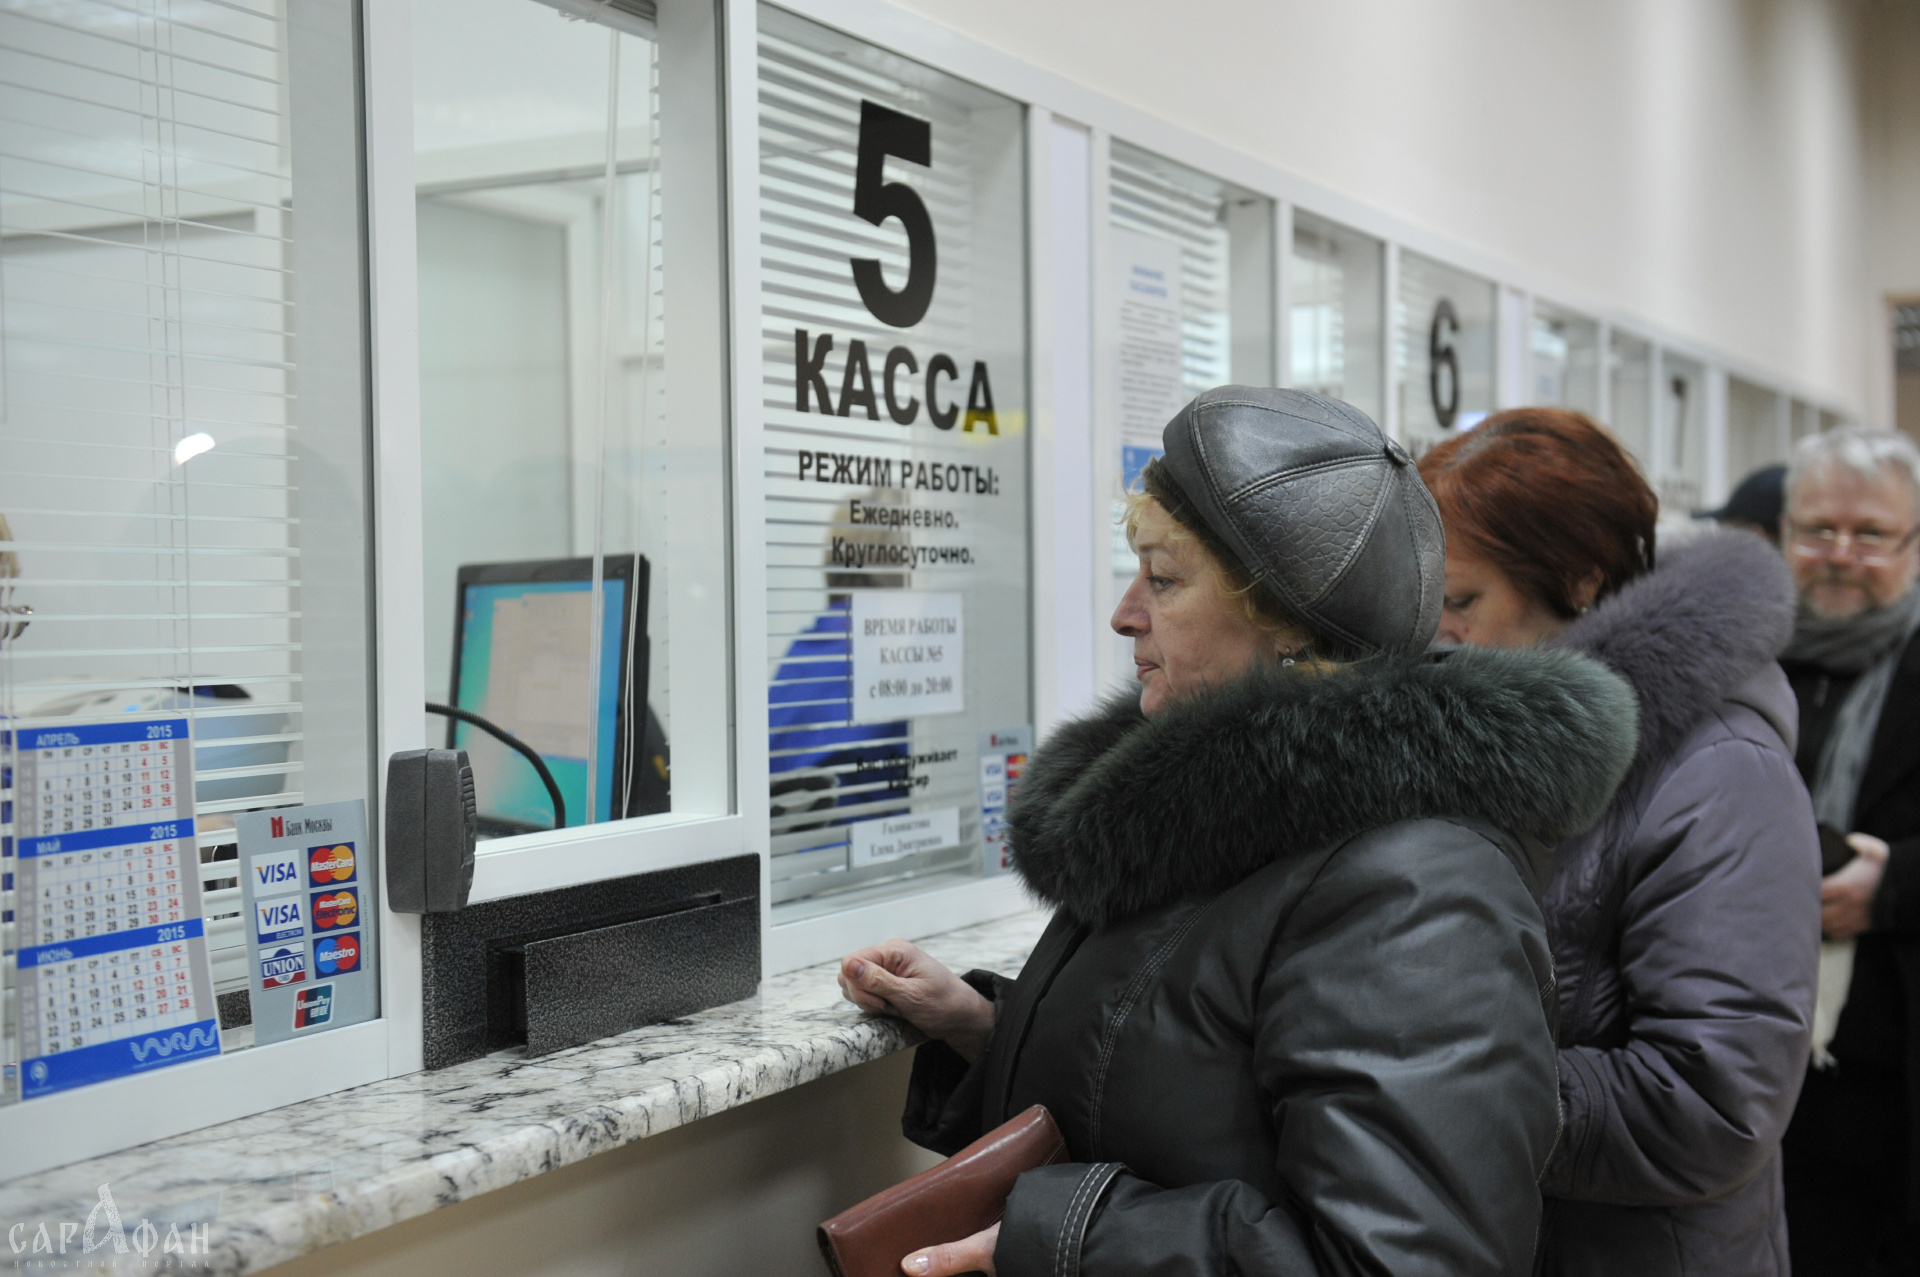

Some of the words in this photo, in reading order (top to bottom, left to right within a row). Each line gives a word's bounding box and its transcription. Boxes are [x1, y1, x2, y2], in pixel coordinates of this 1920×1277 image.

[850, 98, 937, 328] 5
[1429, 296, 1459, 428] 6
[795, 328, 999, 436] КАССА
[799, 450, 892, 487] РЕЖИМ
[901, 459, 999, 495] РАБОТЫ:
[850, 499, 959, 528] Ежедневно.
[832, 537, 975, 568] Круглосуточно.
[864, 618, 906, 636] ВРЕМЯ
[909, 617, 956, 635] РАБОТЫ
[880, 646, 923, 664] КАССЫ
[869, 685, 876, 698] с
[36, 733, 80, 746] АПРЕЛЬ
[146, 725, 173, 738] 2015
[36, 838, 61, 854] МАЙ
[150, 824, 177, 839] 2015
[255, 861, 297, 884] VISA
[310, 856, 354, 872] MasterCard
[260, 903, 300, 926] VISA
[316, 905, 356, 920] Electronic
[319, 897, 351, 909] MasterCard
[36, 947, 74, 964] ИЮНЬ
[157, 926, 186, 942] 2015
[319, 948, 356, 962] Maestro
[263, 955, 304, 976] UNION
